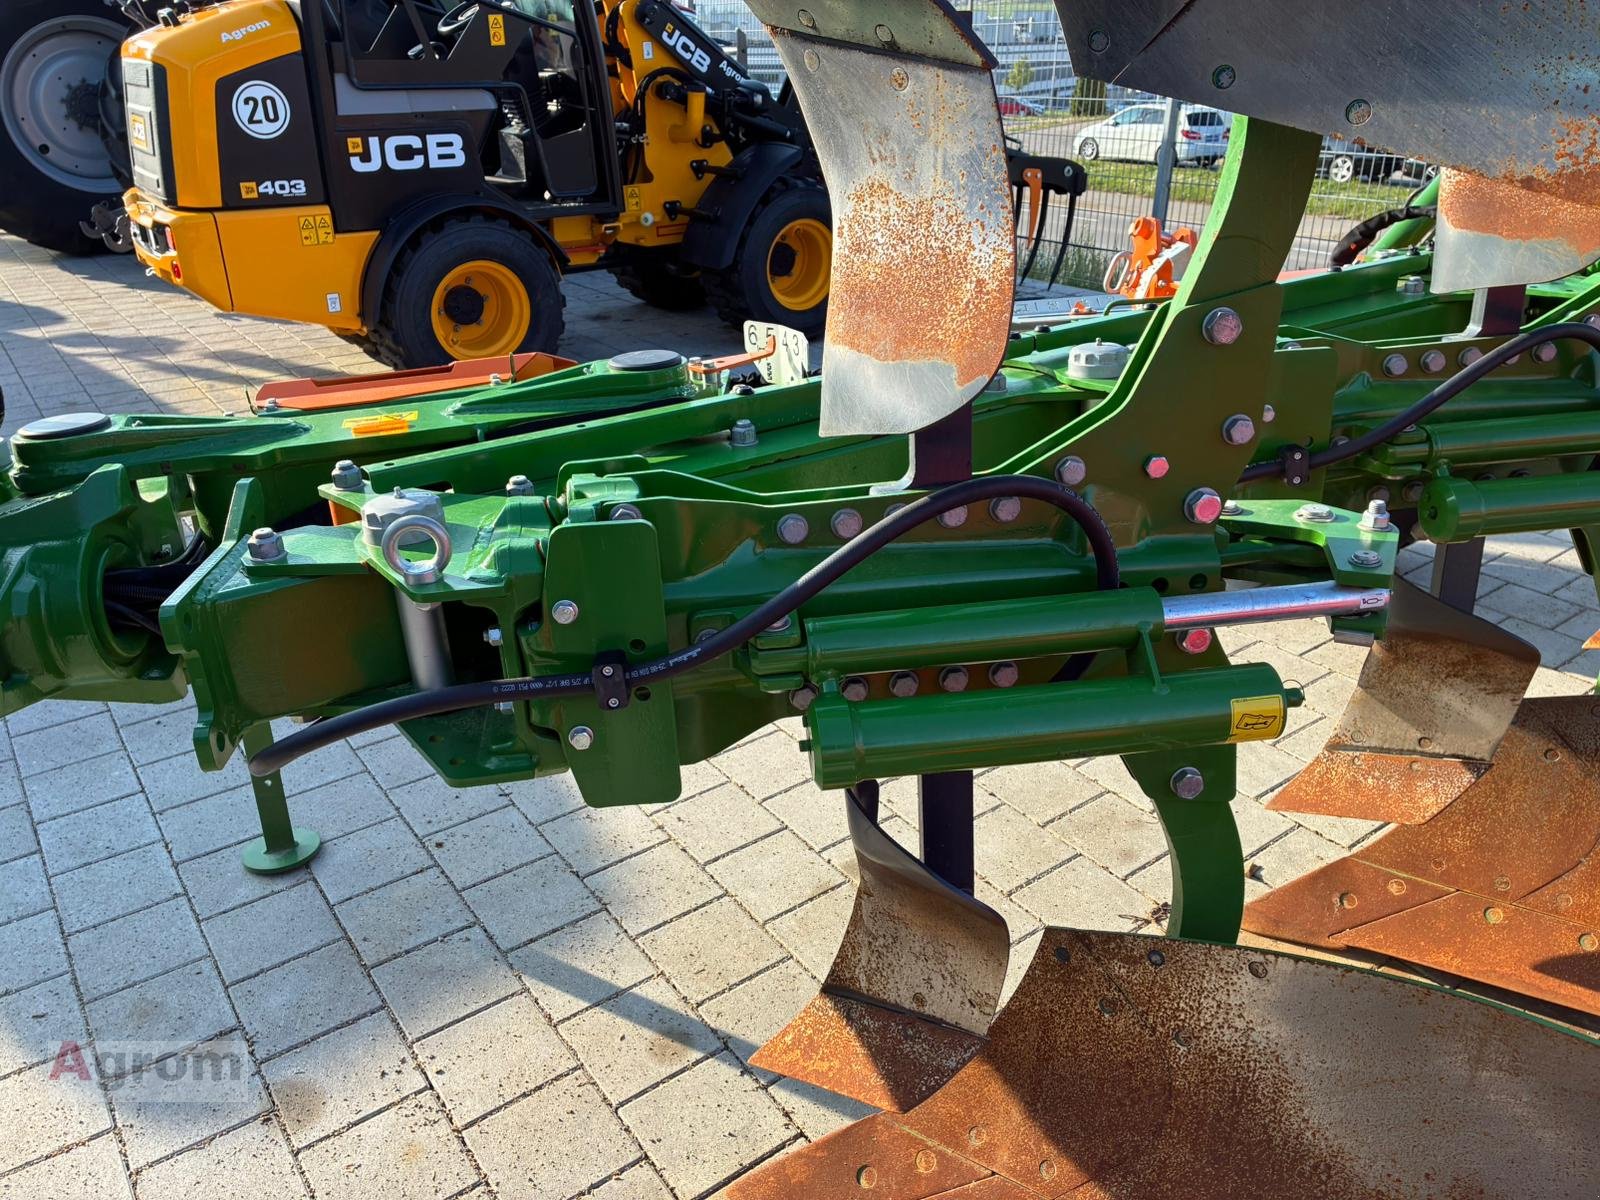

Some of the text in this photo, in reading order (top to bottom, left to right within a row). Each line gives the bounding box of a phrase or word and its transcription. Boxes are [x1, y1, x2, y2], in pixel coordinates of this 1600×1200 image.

[220, 19, 272, 43] Agrom
[660, 22, 711, 73] JCB
[243, 95, 280, 125] 20
[347, 133, 466, 173] JCB
[258, 179, 307, 195] 403
[748, 324, 758, 346] 6
[781, 330, 789, 353] 4
[792, 334, 800, 356] 3
